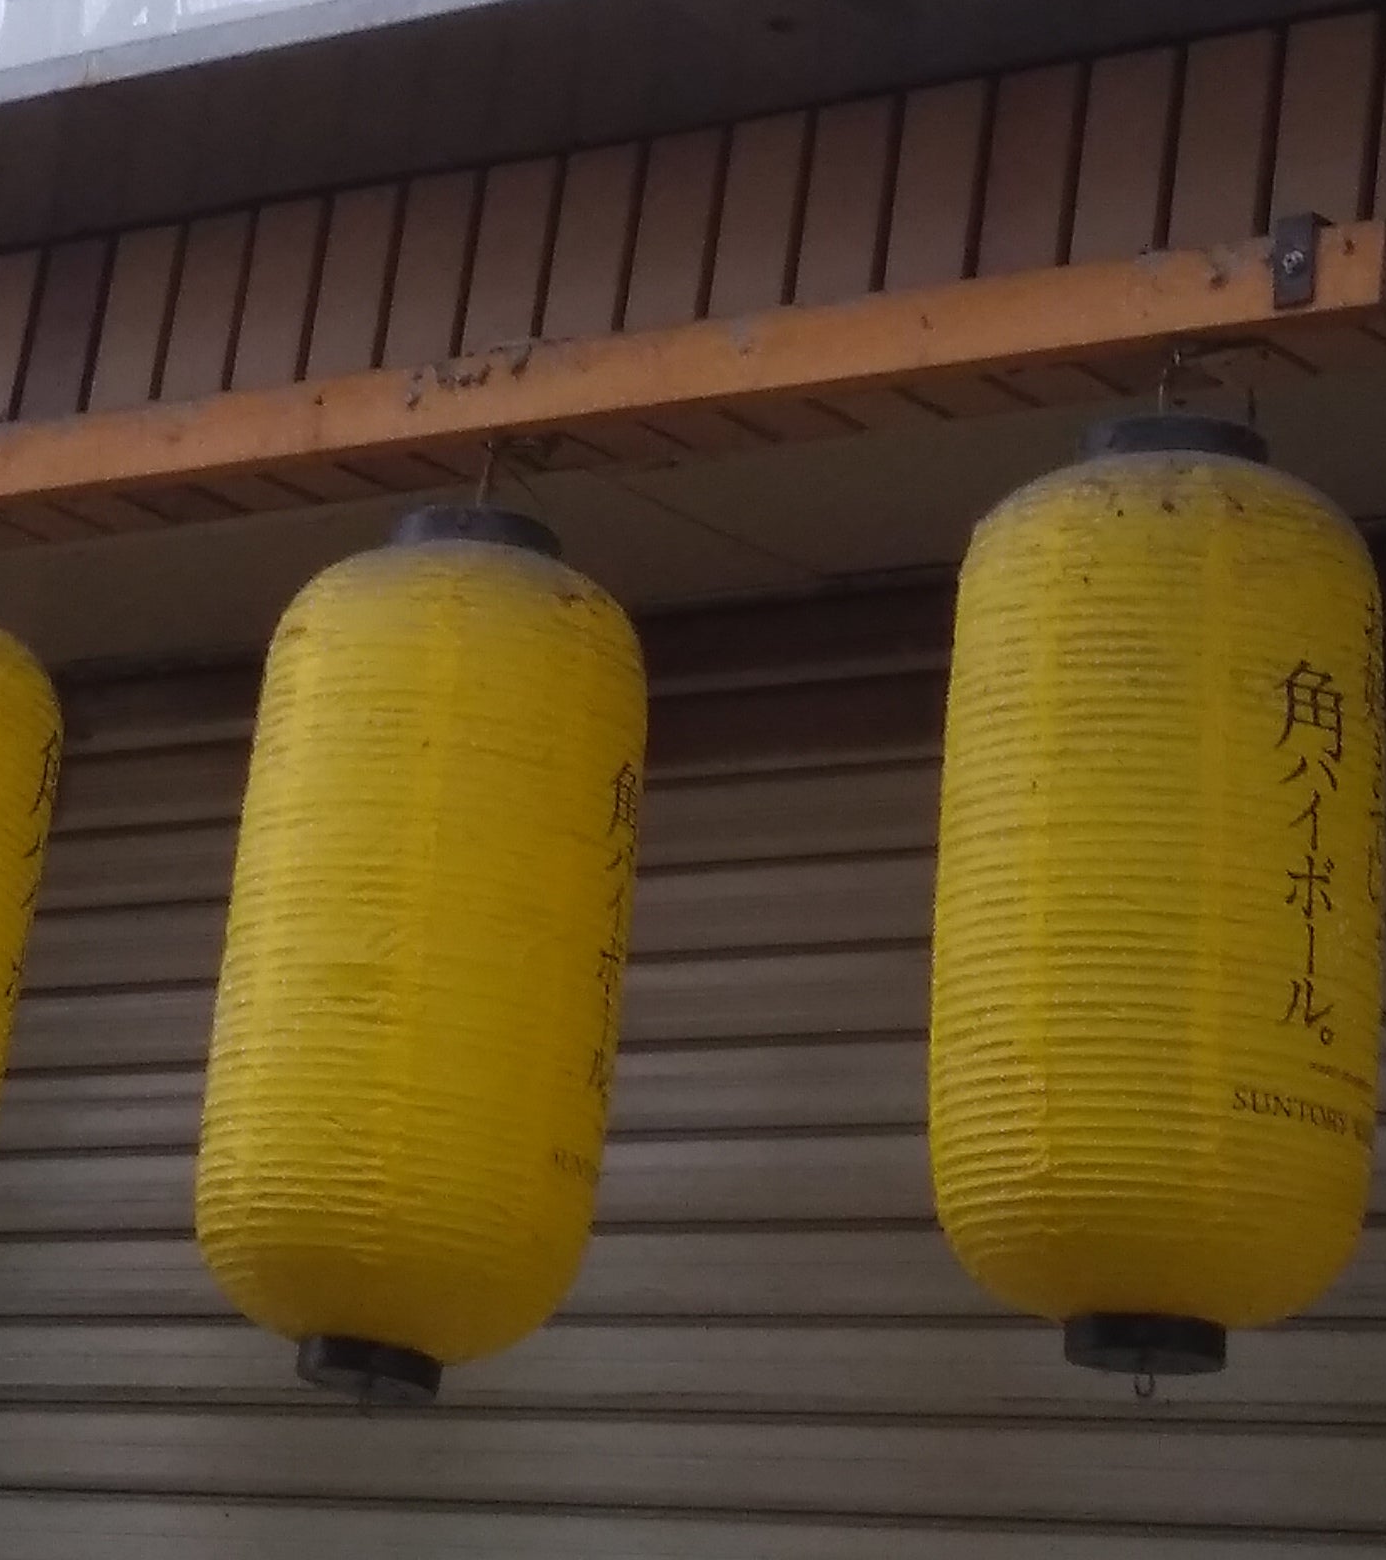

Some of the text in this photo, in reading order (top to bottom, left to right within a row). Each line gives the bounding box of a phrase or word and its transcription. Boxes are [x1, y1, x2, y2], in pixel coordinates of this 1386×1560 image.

[1274, 658, 1346, 1047] 角ハイボール。
